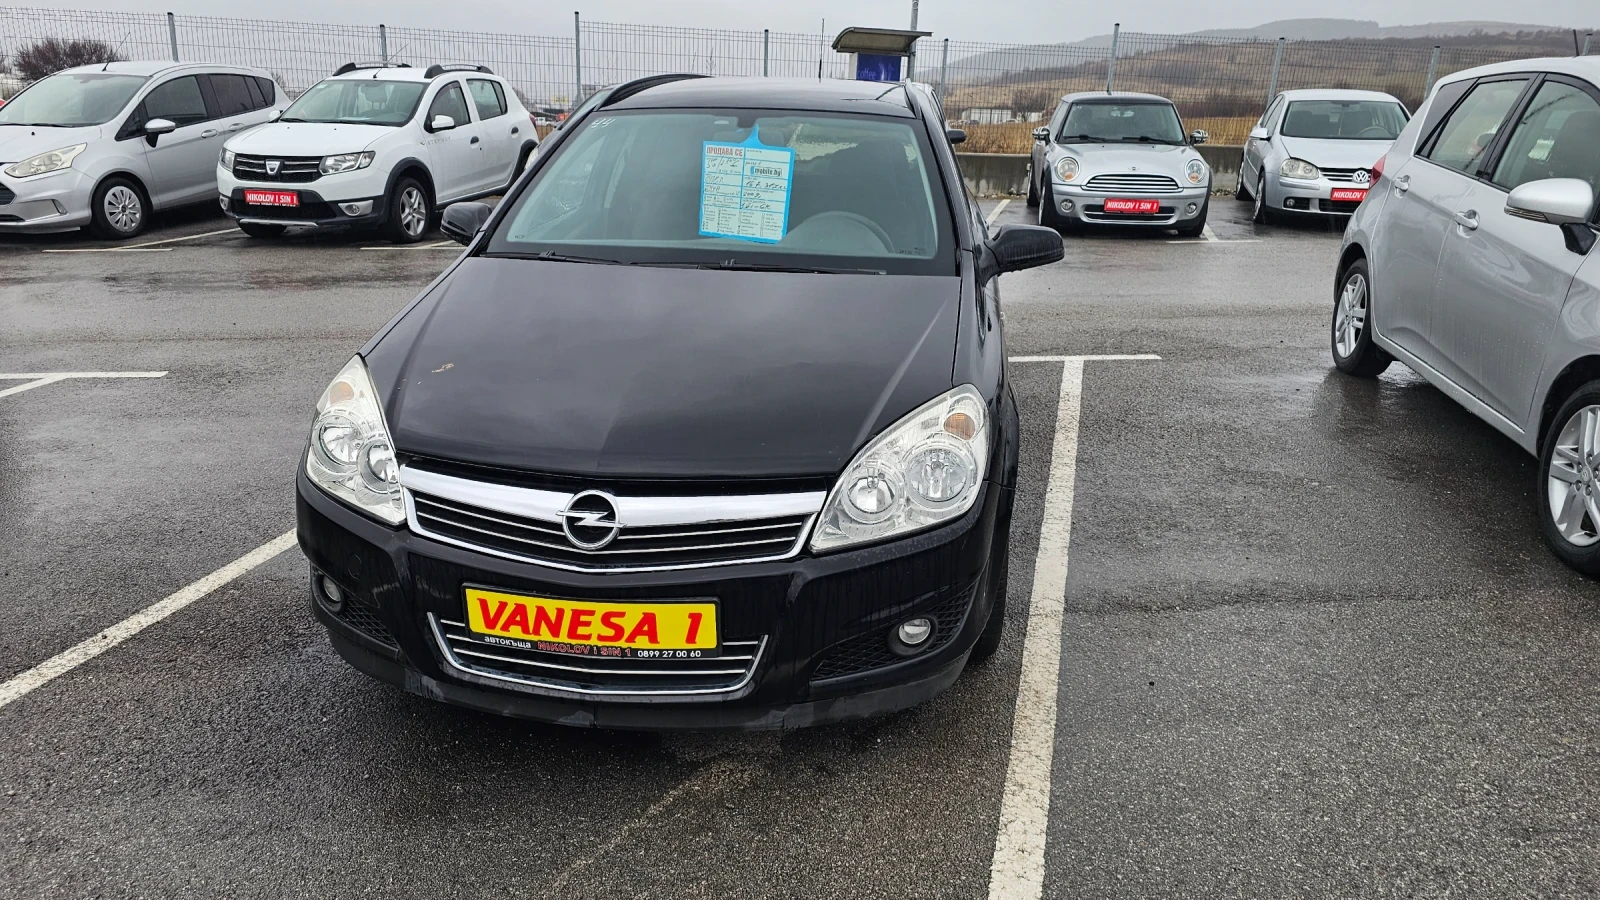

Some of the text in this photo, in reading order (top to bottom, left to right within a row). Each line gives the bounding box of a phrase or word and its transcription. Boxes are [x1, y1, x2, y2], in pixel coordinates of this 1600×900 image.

[857, 68, 876, 79] coffee
[707, 147, 733, 156] ПРОДАВА
[247, 193, 274, 202] NIKOLOV
[280, 194, 291, 202] SIN
[1107, 201, 1135, 209] NIKOLOV
[477, 597, 703, 644] VANESA 1
[484, 635, 531, 649] автокъща
[537, 640, 590, 655] NIKOLOV
[600, 646, 622, 657] SIN
[625, 647, 632, 657] 1
[637, 649, 661, 658] 0899
[662, 650, 675, 658] 27
[676, 650, 689, 658] 00
[690, 650, 702, 658] 60
